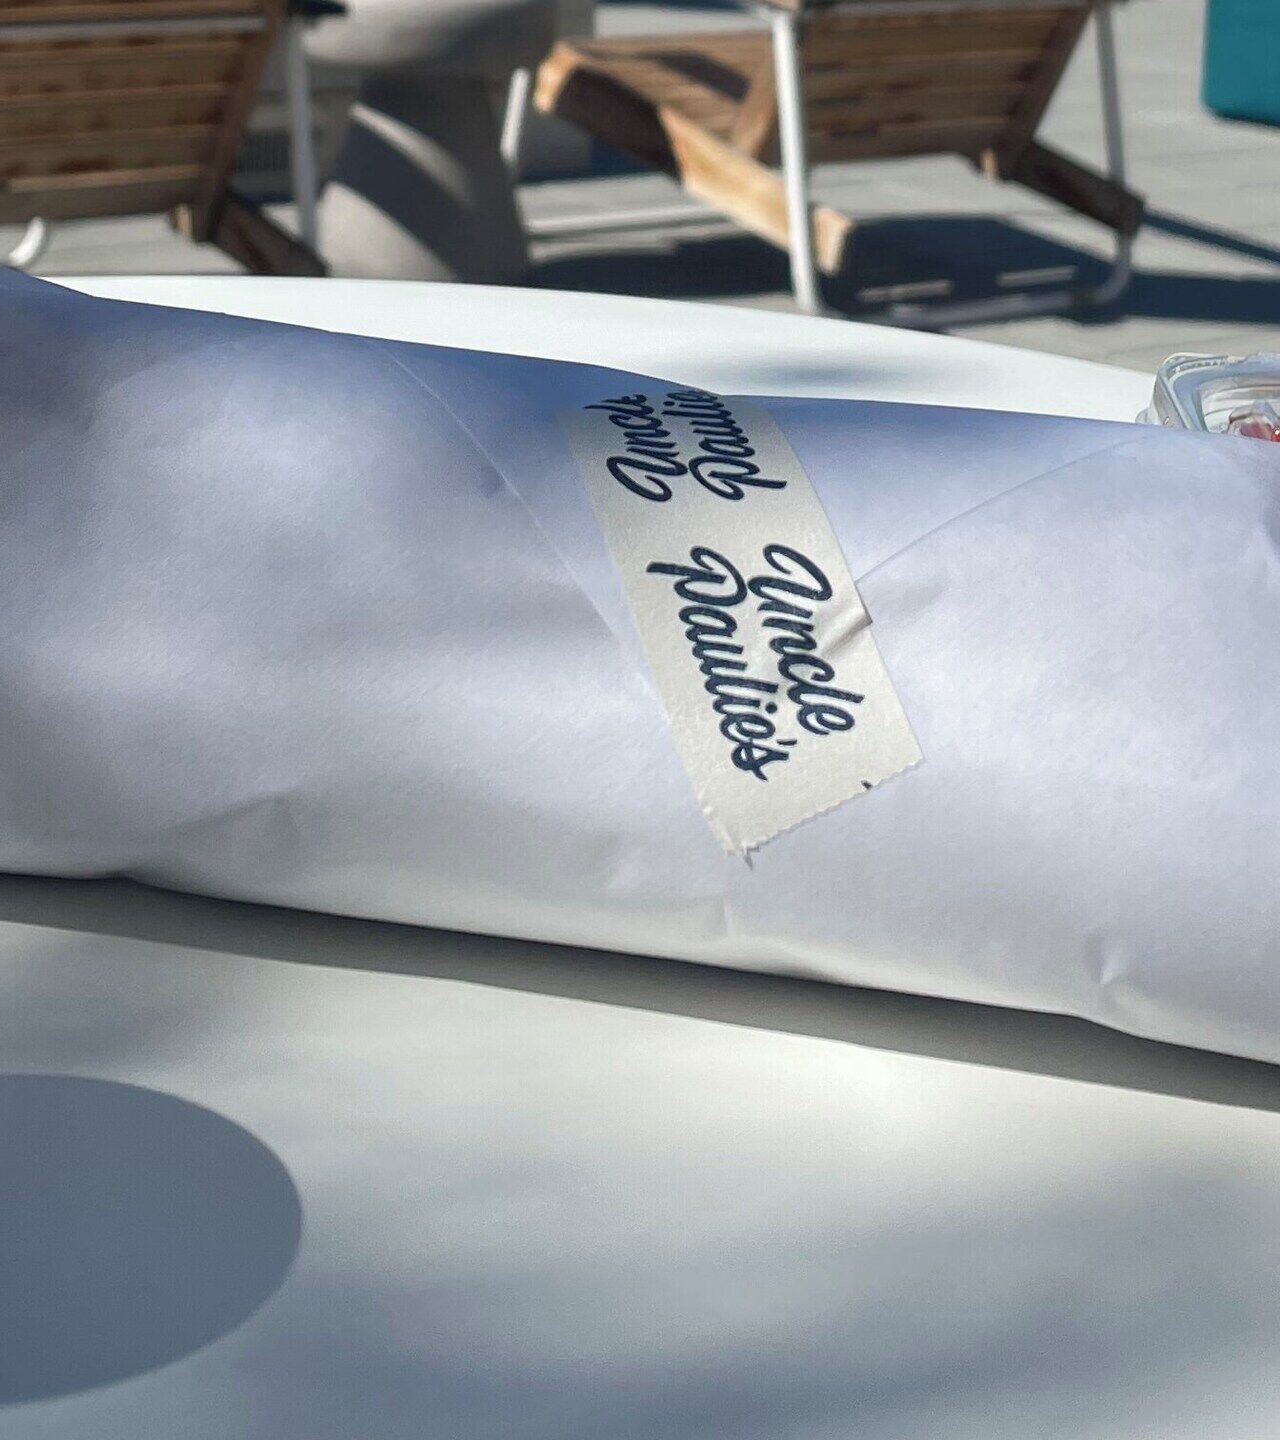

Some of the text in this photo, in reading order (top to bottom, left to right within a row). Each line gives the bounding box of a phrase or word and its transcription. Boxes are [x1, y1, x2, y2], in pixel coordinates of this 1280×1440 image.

[661, 389, 788, 501] Paulie
[646, 546, 797, 781] Paulie's
[747, 544, 864, 735] Uncle
